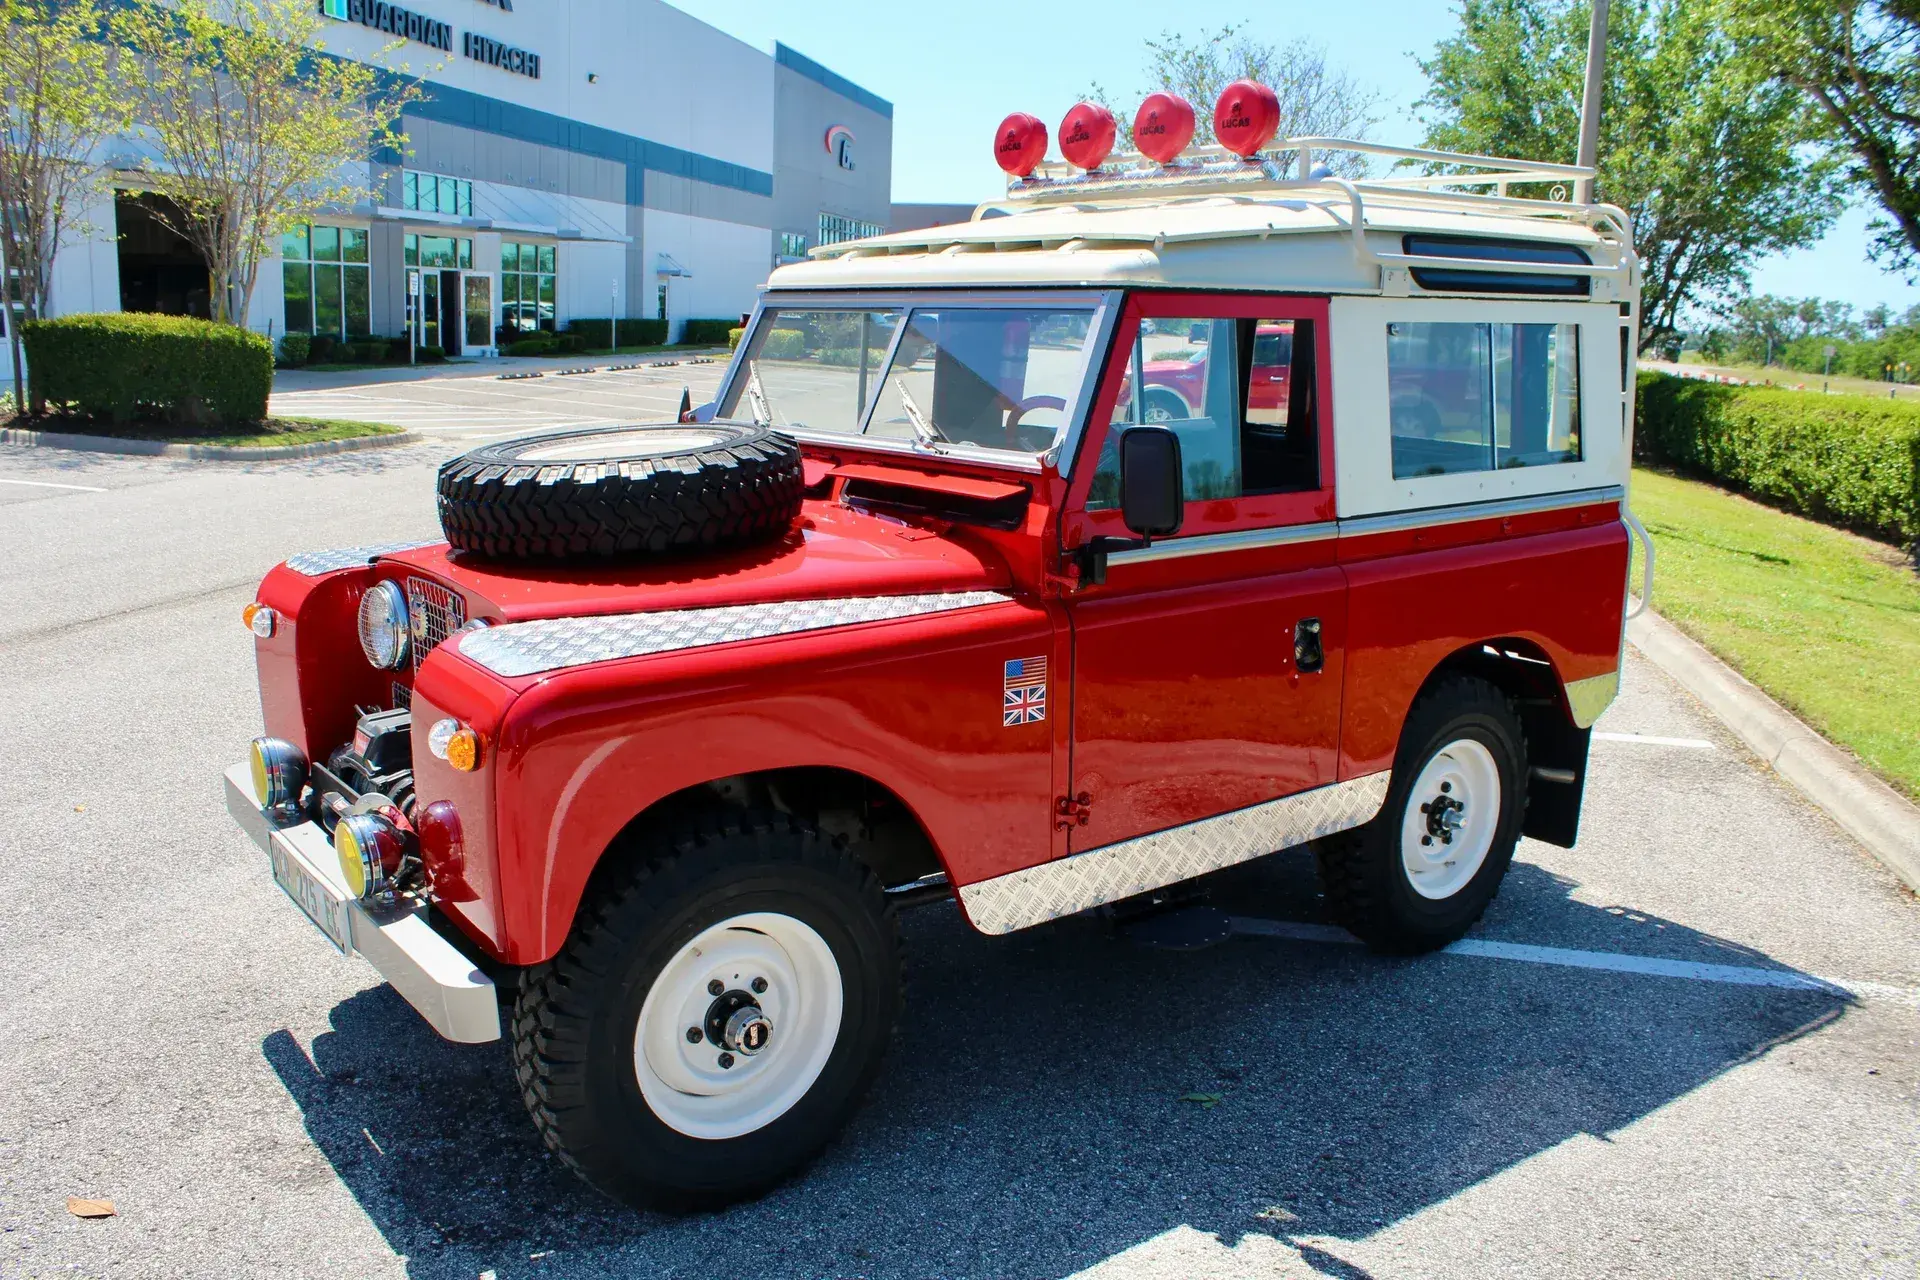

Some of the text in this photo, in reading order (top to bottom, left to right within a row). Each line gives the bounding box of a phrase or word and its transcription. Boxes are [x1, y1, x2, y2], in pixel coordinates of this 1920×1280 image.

[348, 0, 453, 52] GUARDIAN
[465, 32, 541, 80] HITACHI
[1222, 118, 1250, 129] LUCAS
[1140, 125, 1166, 136] LUCAS
[1066, 132, 1090, 144] LUCAS
[999, 142, 1022, 153] LUCAS
[296, 866, 318, 917] 275
